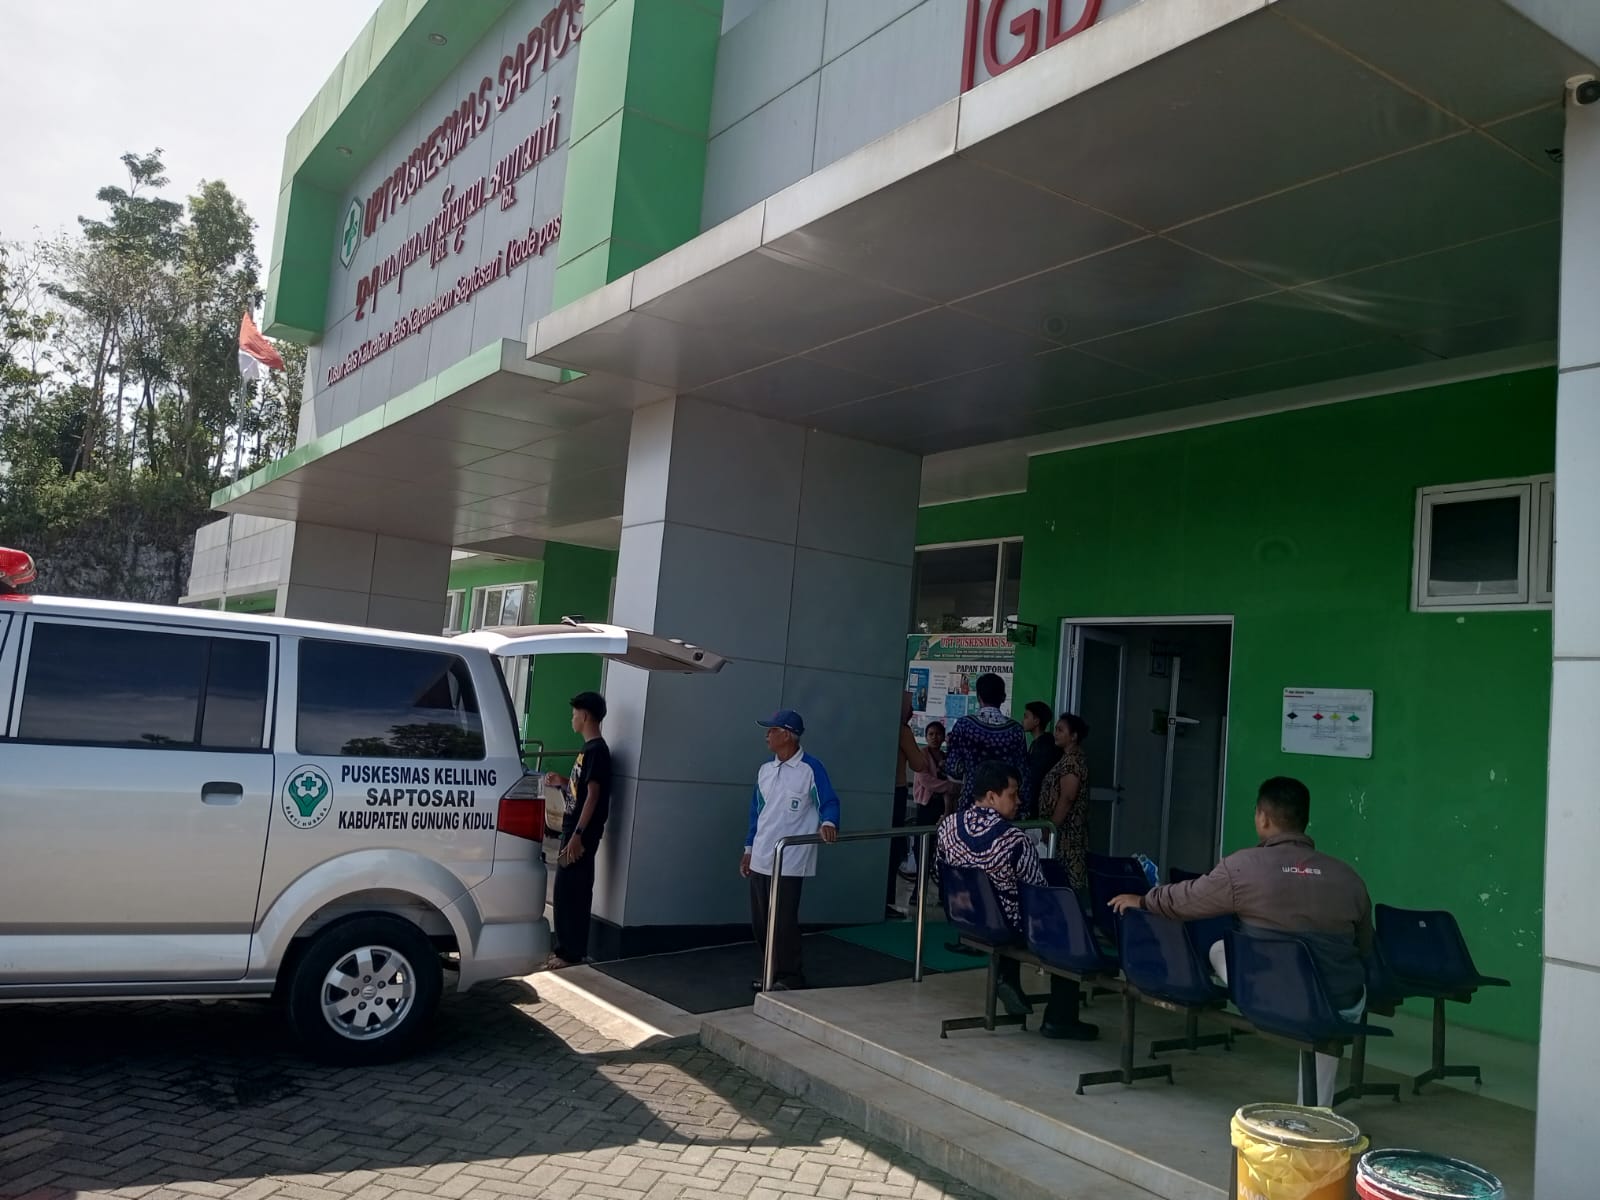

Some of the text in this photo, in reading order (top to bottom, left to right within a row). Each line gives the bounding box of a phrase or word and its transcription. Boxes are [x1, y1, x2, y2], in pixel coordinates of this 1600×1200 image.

[960, 0, 1102, 95] IGD
[364, 176, 393, 238] UPT
[390, 76, 493, 215] PUSKESMAS
[407, 289, 456, 334] Kapanewon
[454, 250, 502, 304] Saptosari
[538, 215, 561, 256] pos
[956, 637, 999, 648] PUSKESMAS
[956, 664, 978, 673] PAPAN
[341, 764, 497, 787] PUSKESMAS KELILING
[366, 787, 475, 808] SAPTOSARI
[338, 810, 495, 830] KABUPATEN GUNUNG KIDUL
